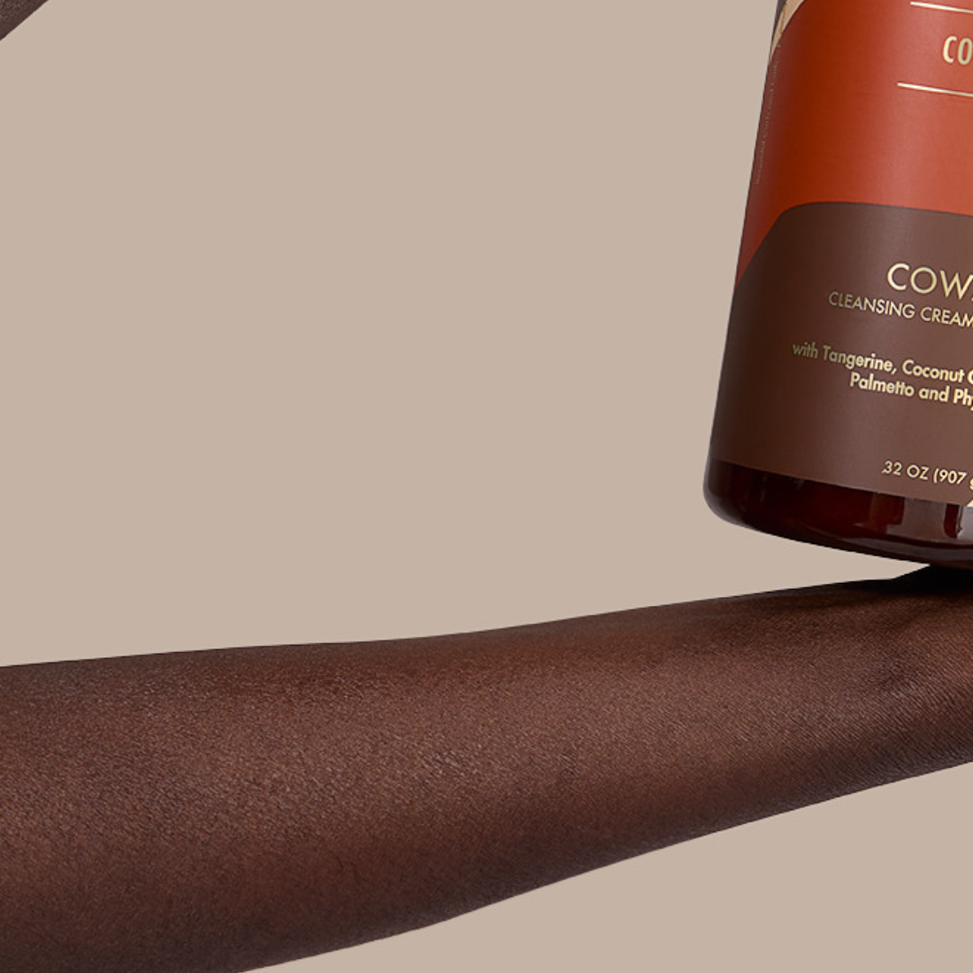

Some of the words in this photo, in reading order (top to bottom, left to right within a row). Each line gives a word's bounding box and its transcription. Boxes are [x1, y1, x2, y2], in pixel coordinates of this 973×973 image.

[828, 290, 915, 319] CLEANSING
[792, 341, 818, 359] with
[823, 345, 897, 374] Tangerine,
[902, 359, 965, 384] Coconut
[849, 371, 914, 398] Palmetto
[918, 385, 950, 403] and
[906, 464, 929, 481] OZ
[933, 467, 967, 484] (907
